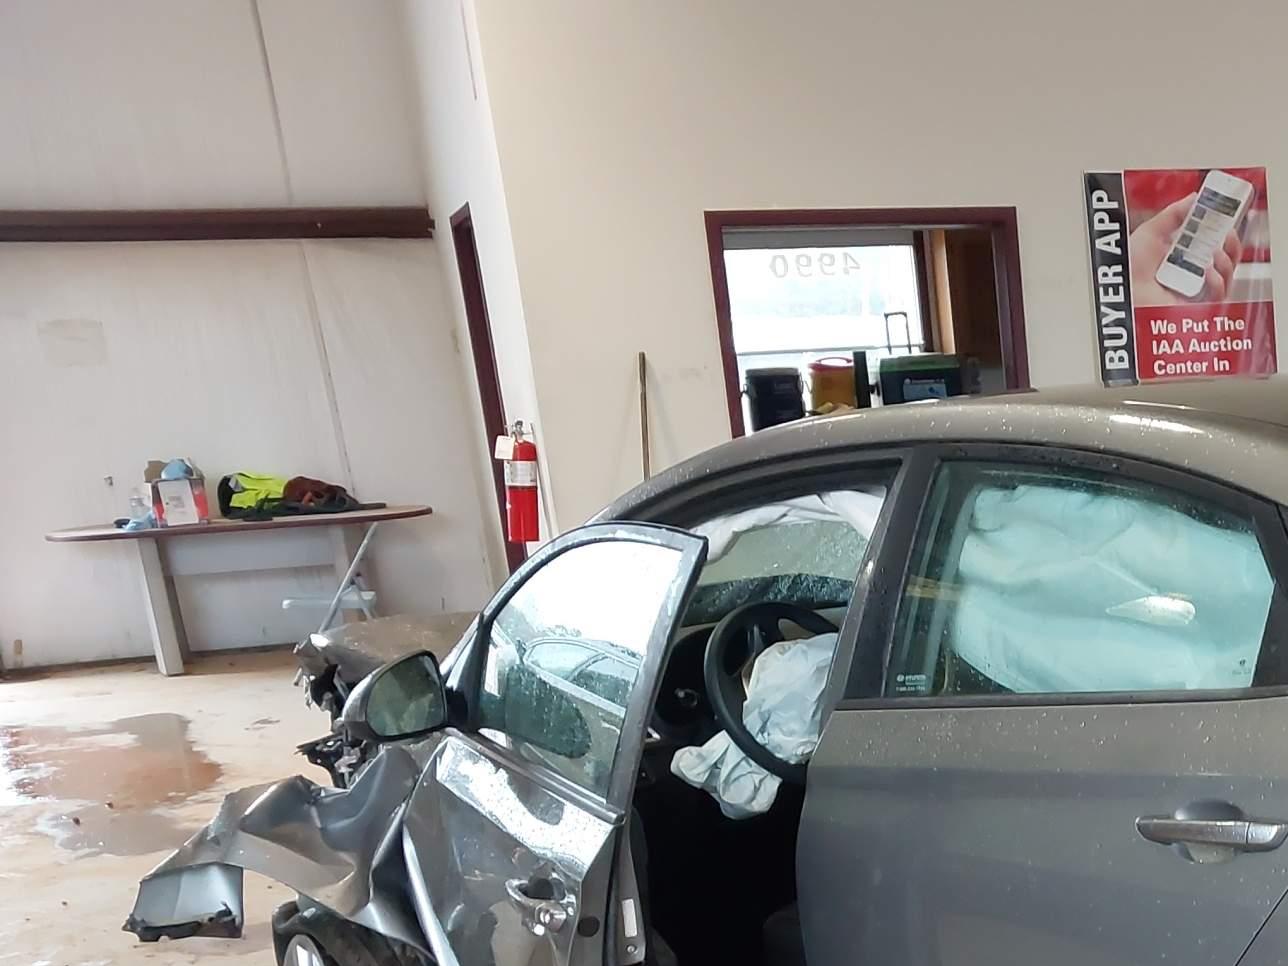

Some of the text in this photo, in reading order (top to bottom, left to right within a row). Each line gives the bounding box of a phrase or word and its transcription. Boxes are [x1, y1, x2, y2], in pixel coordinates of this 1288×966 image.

[1091, 189, 1130, 370] BUYER APP
[1150, 316, 1245, 335] We Put The
[1152, 337, 1252, 355] IAA Auction
[1153, 358, 1230, 375] Center In
